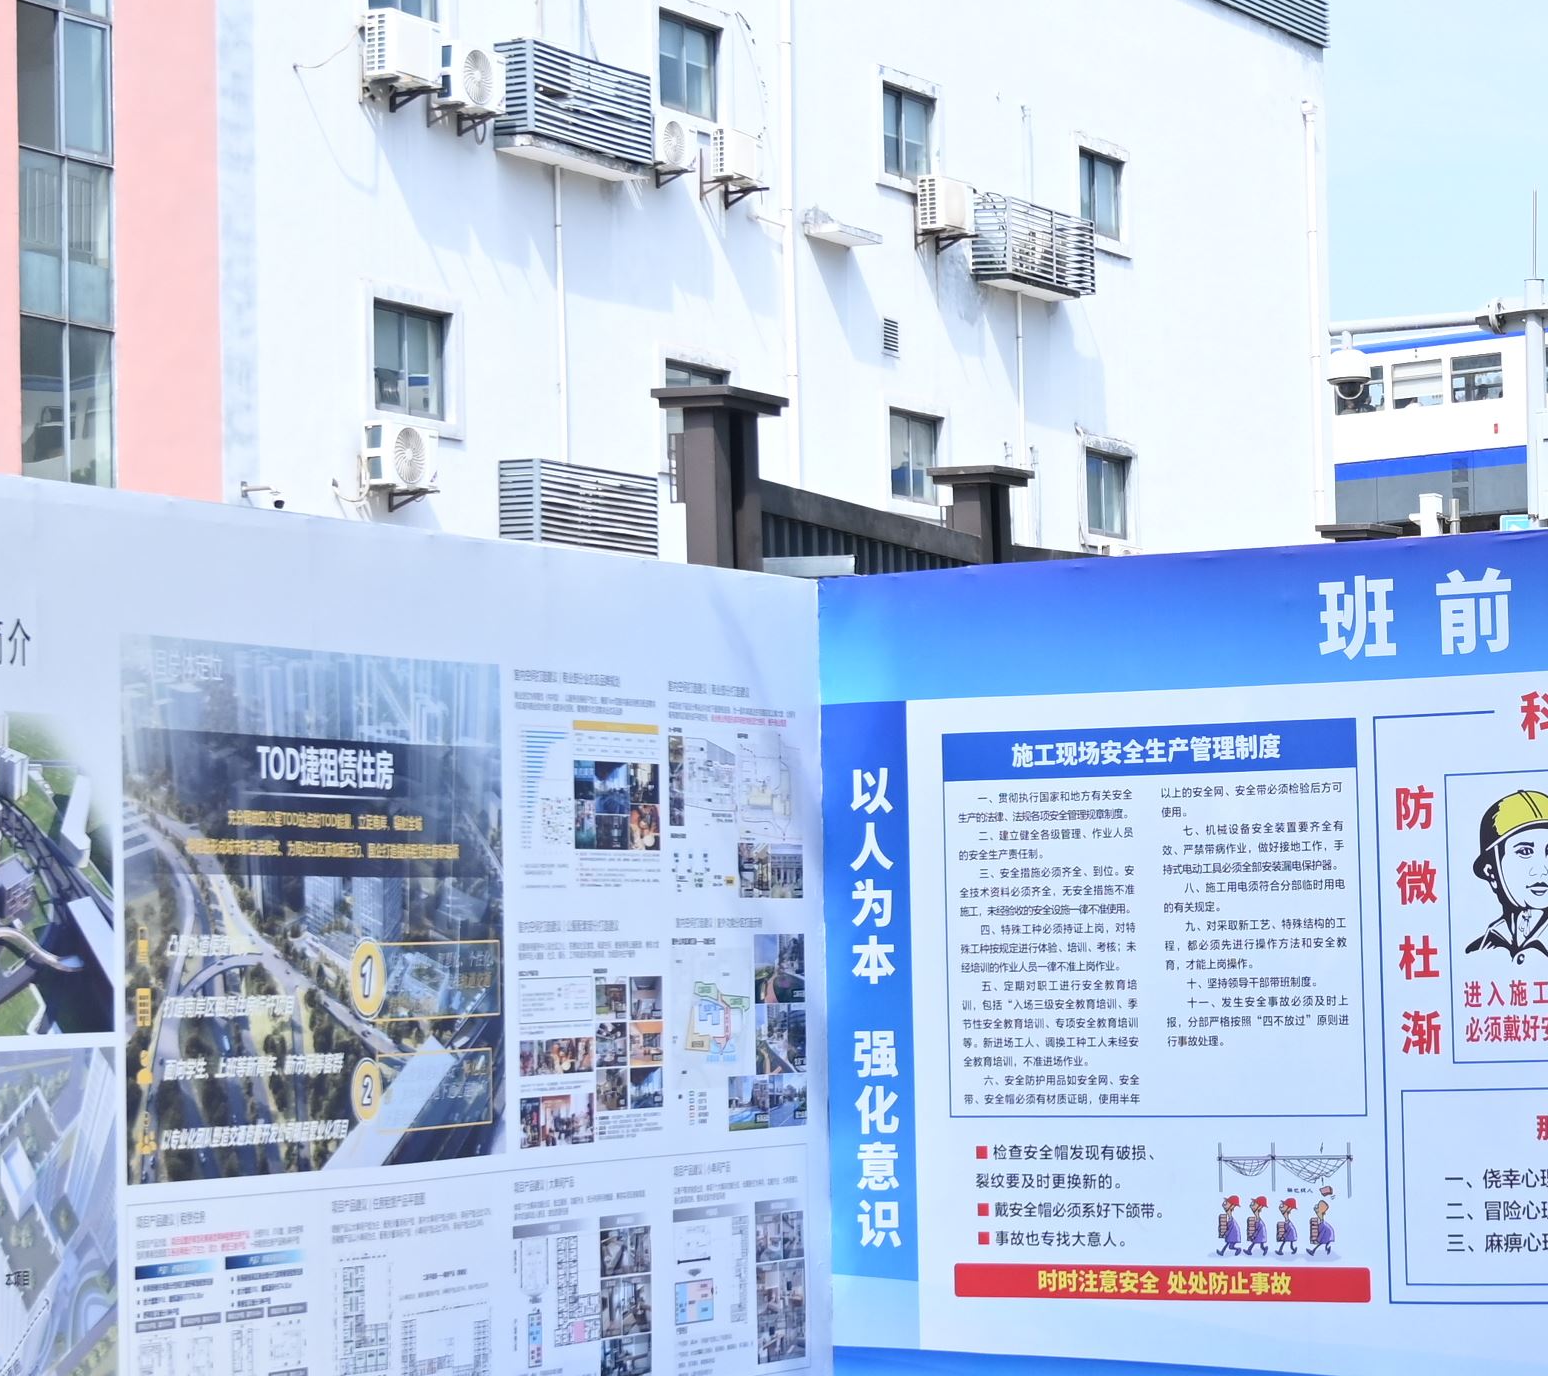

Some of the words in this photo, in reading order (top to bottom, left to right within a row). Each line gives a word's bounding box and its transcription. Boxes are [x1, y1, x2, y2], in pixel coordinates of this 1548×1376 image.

[1011, 733, 1281, 768] 施工现场安全生产管理制度
[257, 745, 395, 791] TOD捷租赁住房
[978, 789, 1133, 804] 一、贯彻执行国家和地方有关安全
[1161, 781, 1342, 799] 以上的安全网、安全带必须检验后方可
[1161, 806, 1188, 818] 使用。
[979, 827, 1134, 841] 二、建立健全各级管理、作业人员
[1183, 820, 1344, 837] 七、机械设备安全装置要齐全有
[959, 848, 1044, 861] 的安全生产责任制。
[980, 865, 1135, 879] 三、安全措施必须齐全、到位。安
[1162, 859, 1338, 876] 持式电动工具必须全部安装漏电保护器。
[850, 767, 895, 985] 以人为本
[959, 884, 1135, 899] 全技术资料必须齐全，无安全措施不准
[1184, 879, 1346, 894] 八、施工用电须符合分部临时用电
[1163, 901, 1222, 914] 的有关规定。
[980, 922, 1136, 935] 四、特殊工种必须持证上岗，对特
[1185, 917, 1347, 933] 九、对采取新工艺、特殊结构的工
[1394, 787, 1442, 1058] 防微杜渐
[1164, 936, 1348, 952] 程，都必须先进行操作方法和安全教
[961, 961, 1120, 973] 经培训的作业人员一律不准上岗作业。
[1165, 958, 1254, 971] 育，才能上岗操作。
[981, 979, 1138, 992] 五、定期对职工进行安全教育培
[1187, 976, 1318, 990] 十、坚持领导干部带班制度。
[1187, 995, 1349, 1009] 十一、发生安全事故必须及时上
[962, 1017, 1139, 1030] 节性安全教育培训、专项安全教育培训
[963, 1036, 1139, 1049] 等。新进场工人、调换工种工人未经安
[1167, 1035, 1225, 1047] 行事故处理。
[963, 1056, 1089, 1067] 全教育培训，不准进场作业。
[983, 1074, 1140, 1086] 六、安全防护用品如安全网、安全
[964, 1093, 1141, 1105] 带、安全帽必须有材质证明，使用半年
[854, 1029, 902, 1249] 强化意识
[993, 1143, 1156, 1162] 检查安全帽发现有破损、
[975, 1173, 1123, 1191] 裂纹要及时更换新的。
[994, 1201, 1164, 1220] 戴安全帽必须系好下颌带。
[995, 1230, 1128, 1248] 事故也专找大意人。
[1038, 1270, 1160, 1295] 时时注意安全
[1167, 1271, 1293, 1297] 处处防止事故
